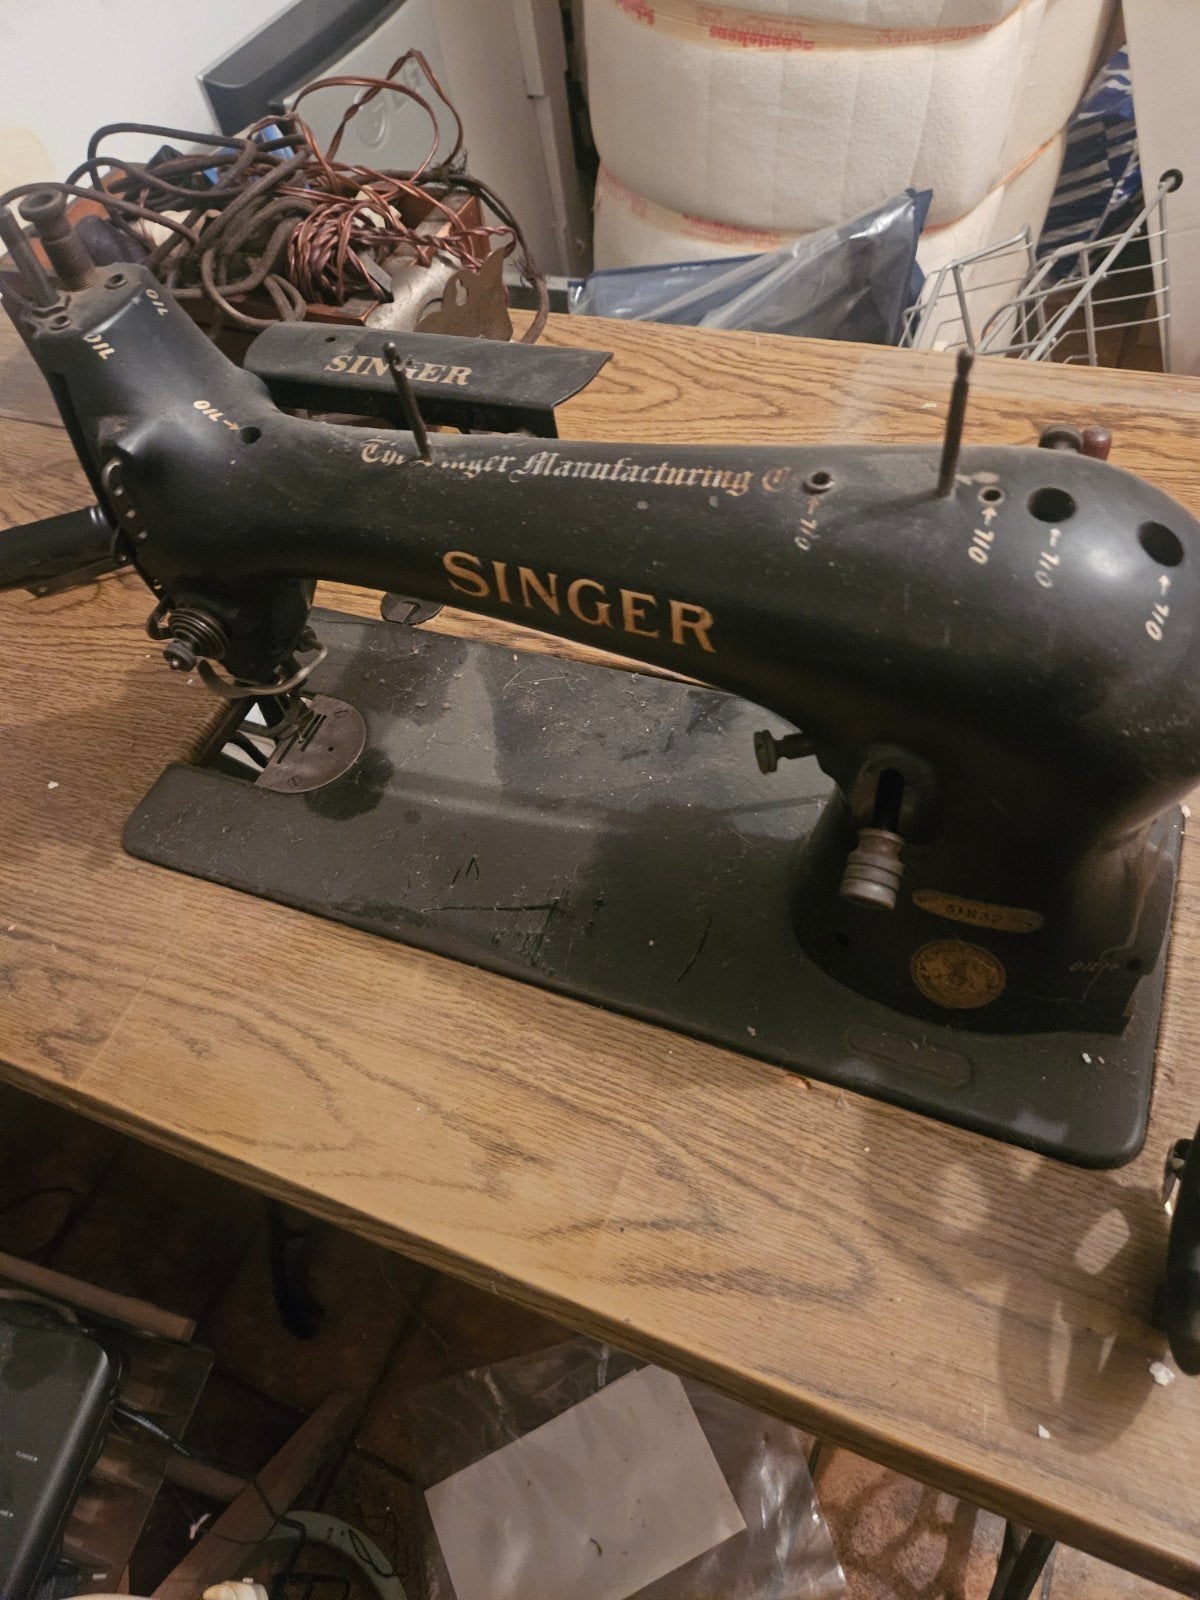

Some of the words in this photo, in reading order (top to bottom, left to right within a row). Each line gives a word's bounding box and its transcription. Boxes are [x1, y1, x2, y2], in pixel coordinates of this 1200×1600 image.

[145, 288, 169, 316] OIL
[83, 333, 115, 360] OIL
[193, 400, 225, 422] OIL
[509, 451, 753, 496] Manufacturing
[794, 518, 820, 551] OIL
[967, 528, 995, 564] OIL
[1034, 551, 1060, 588] OIL
[442, 550, 716, 653] SINGER
[1145, 602, 1170, 641] OIL
